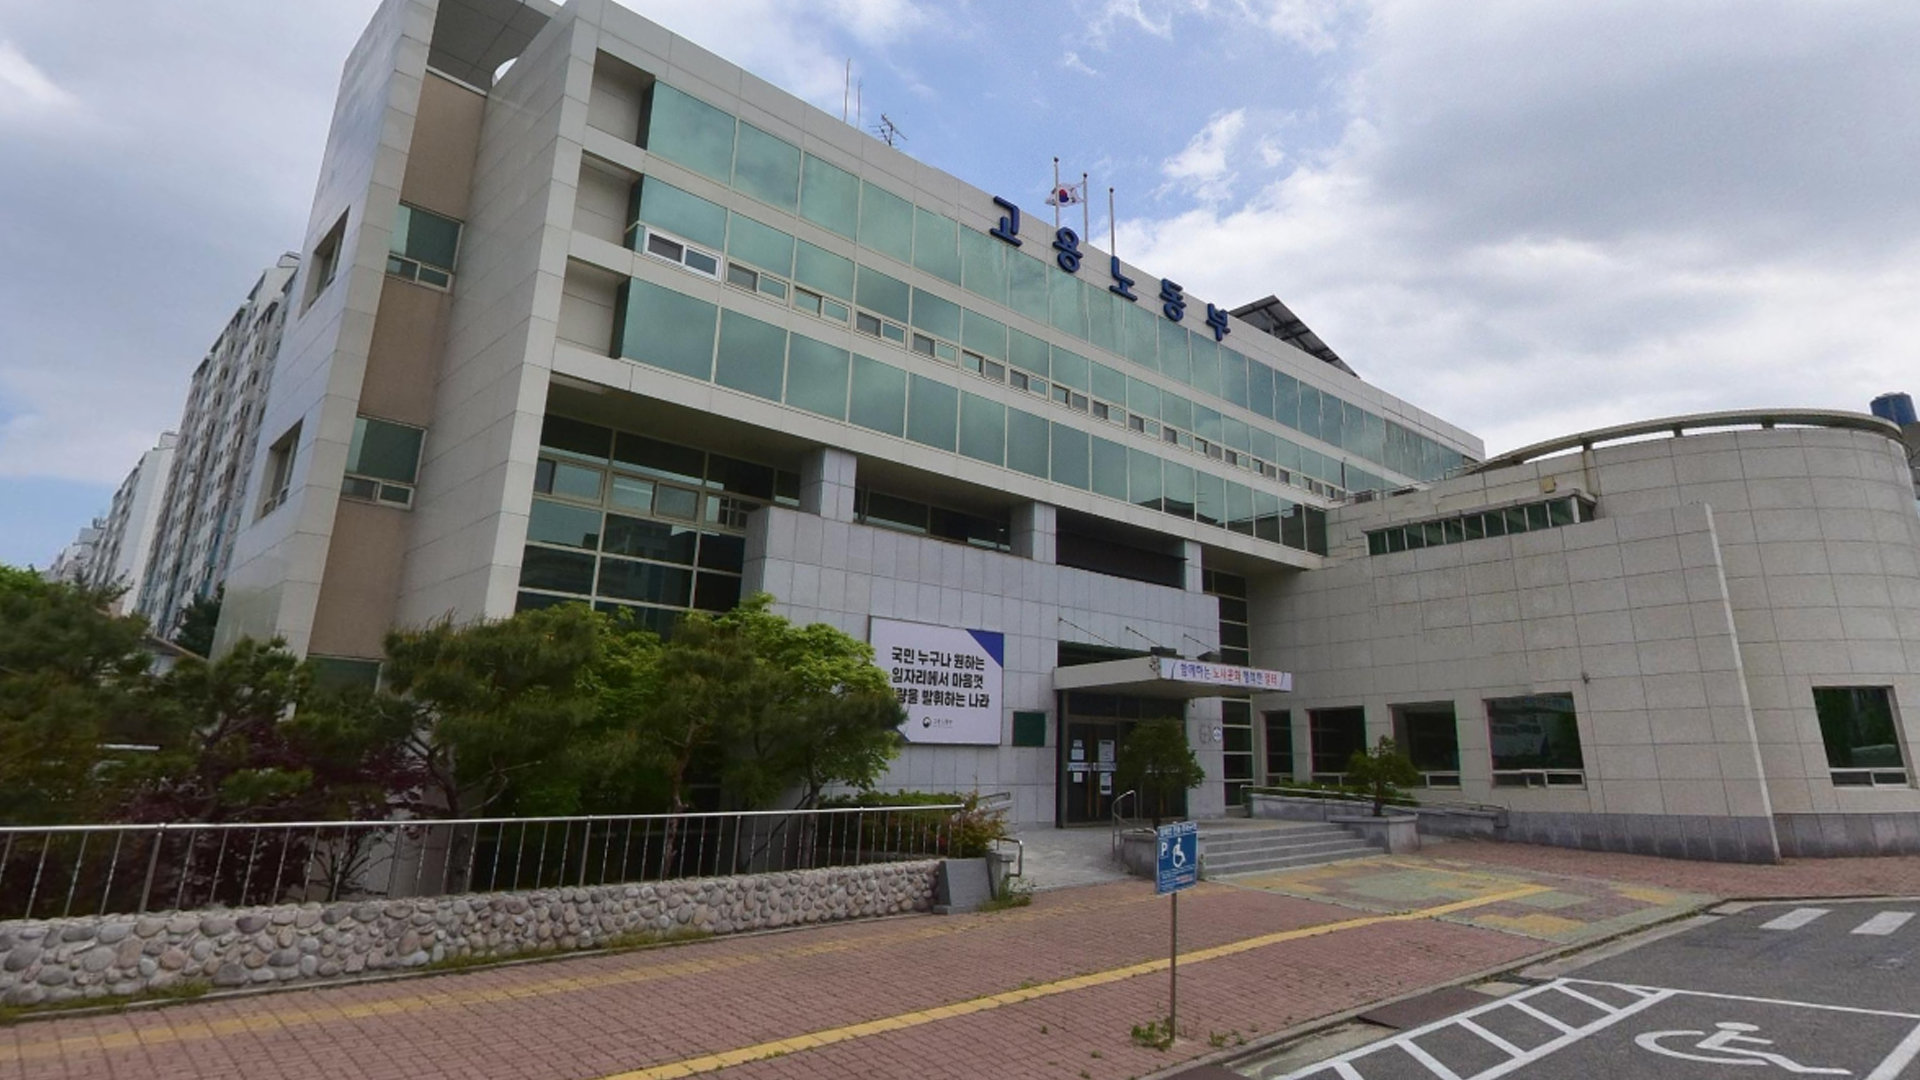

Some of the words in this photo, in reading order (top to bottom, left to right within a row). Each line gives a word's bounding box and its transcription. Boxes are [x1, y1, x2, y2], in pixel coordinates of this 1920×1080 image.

[990, 195, 1232, 342] 고용노동부
[892, 646, 914, 665] 국민
[918, 650, 951, 668] 누구나
[954, 653, 985, 671] 원하는
[891, 667, 949, 687] 일자리에서
[952, 672, 983, 690] 마음껏
[1180, 663, 1211, 680] 함께하는
[892, 687, 918, 704] 량을
[922, 689, 965, 707] 발휘하는
[968, 693, 989, 708] 나라
[1161, 842, 1167, 857] P
